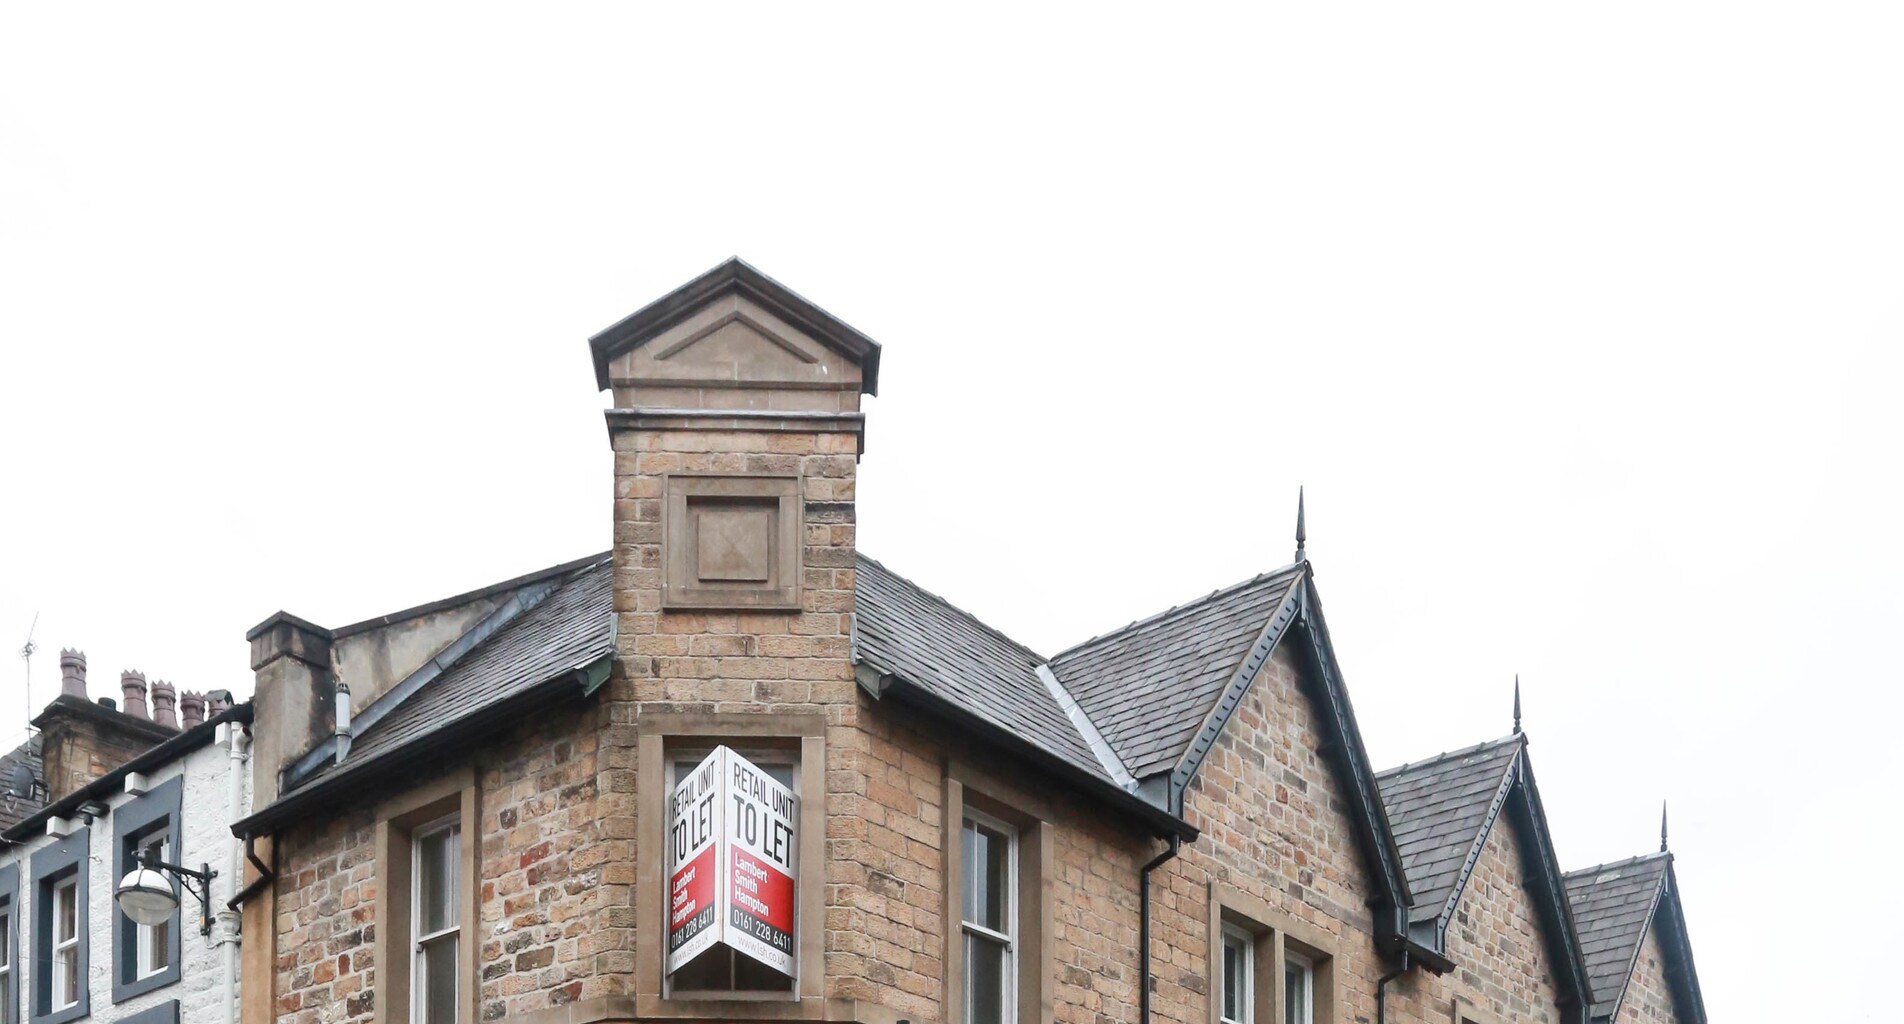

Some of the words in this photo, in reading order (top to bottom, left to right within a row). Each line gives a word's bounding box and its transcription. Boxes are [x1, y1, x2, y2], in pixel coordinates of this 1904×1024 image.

[672, 780, 696, 822] RETAIL
[698, 760, 715, 797] UNIT
[734, 761, 769, 807] RETAIL
[772, 789, 795, 823] UNIT
[671, 817, 687, 868] TO
[692, 792, 715, 852] LET
[733, 793, 757, 847] TO
[763, 812, 794, 869] LET
[673, 866, 696, 895] Lambert
[734, 869, 758, 895] Smith
[735, 851, 768, 884] Lambert
[672, 887, 688, 910] Smith
[672, 898, 696, 926] Hampton
[734, 885, 769, 917] Hampton
[671, 928, 685, 949] 0161
[685, 917, 697, 939] 228
[698, 906, 713, 930] 6411
[733, 909, 752, 932] 0161
[755, 920, 771, 941] 228
[773, 930, 791, 952] 6411
[737, 935, 787, 967] www.lsh.co.uk
